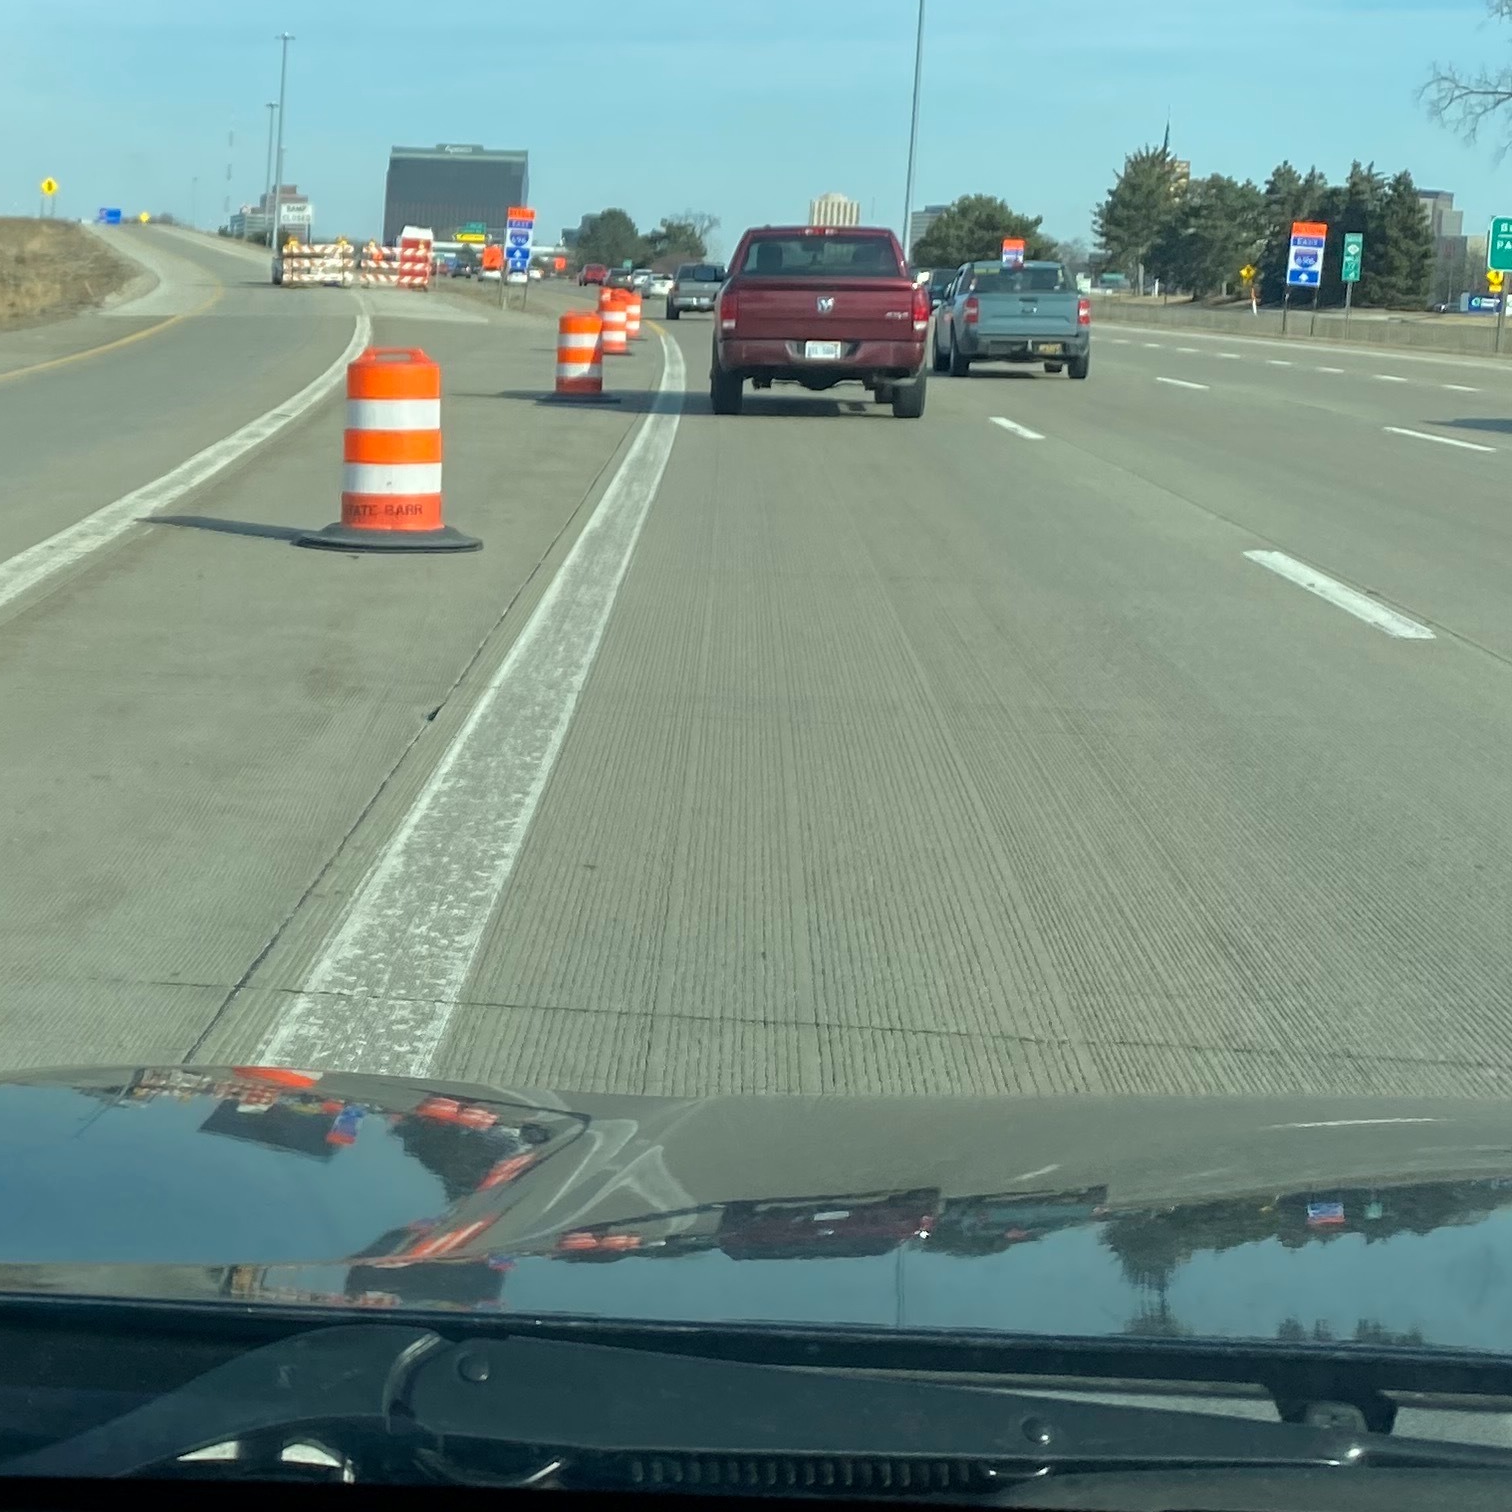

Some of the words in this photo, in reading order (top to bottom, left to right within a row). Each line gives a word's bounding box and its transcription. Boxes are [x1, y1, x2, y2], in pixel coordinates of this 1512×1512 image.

[511, 220, 530, 228] EAST
[511, 236, 527, 244] 696
[384, 503, 423, 516] BARR
